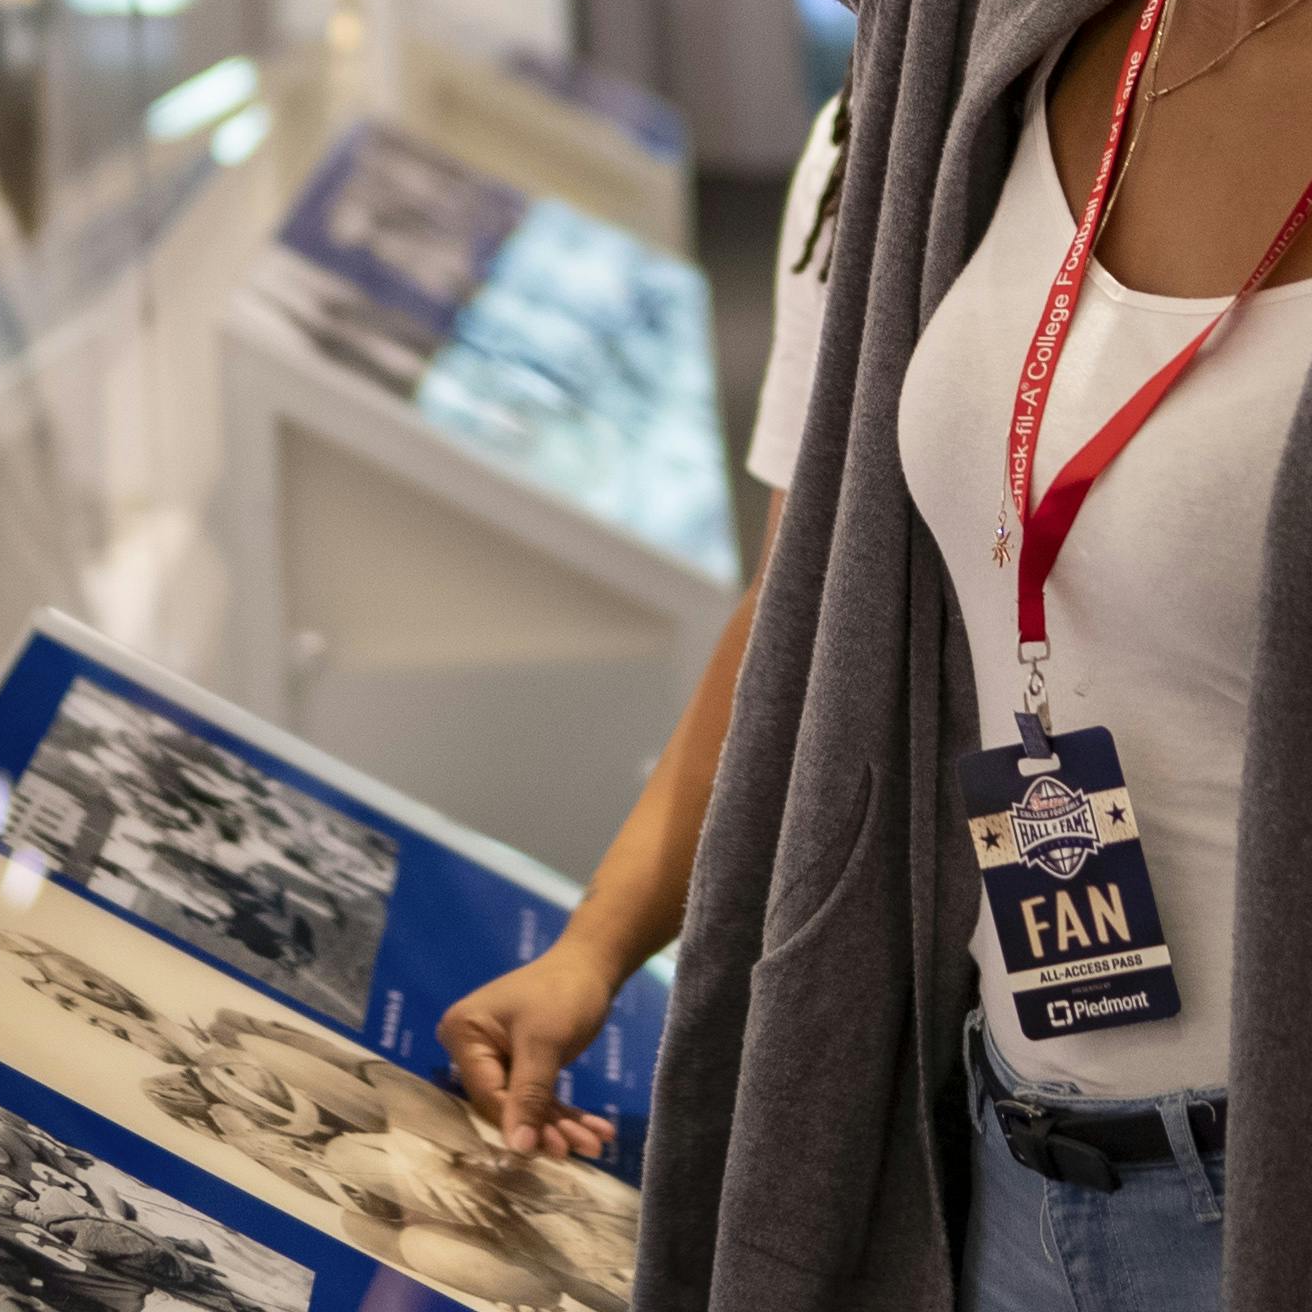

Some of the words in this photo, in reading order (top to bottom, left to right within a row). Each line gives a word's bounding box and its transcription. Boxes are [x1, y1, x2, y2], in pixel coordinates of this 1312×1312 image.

[1027, 292, 1070, 381] College
[1056, 197, 1100, 286] Football
[1091, 147, 1114, 193] Hall
[1115, 50, 1143, 117] Fame
[1016, 821, 1052, 849] HALL
[1058, 808, 1093, 835] FAME
[1019, 882, 1132, 958] FAN
[1039, 959, 1111, 984] ALL-ACCESS
[1111, 953, 1143, 971] PASS
[1073, 990, 1150, 1020] Piedmont
